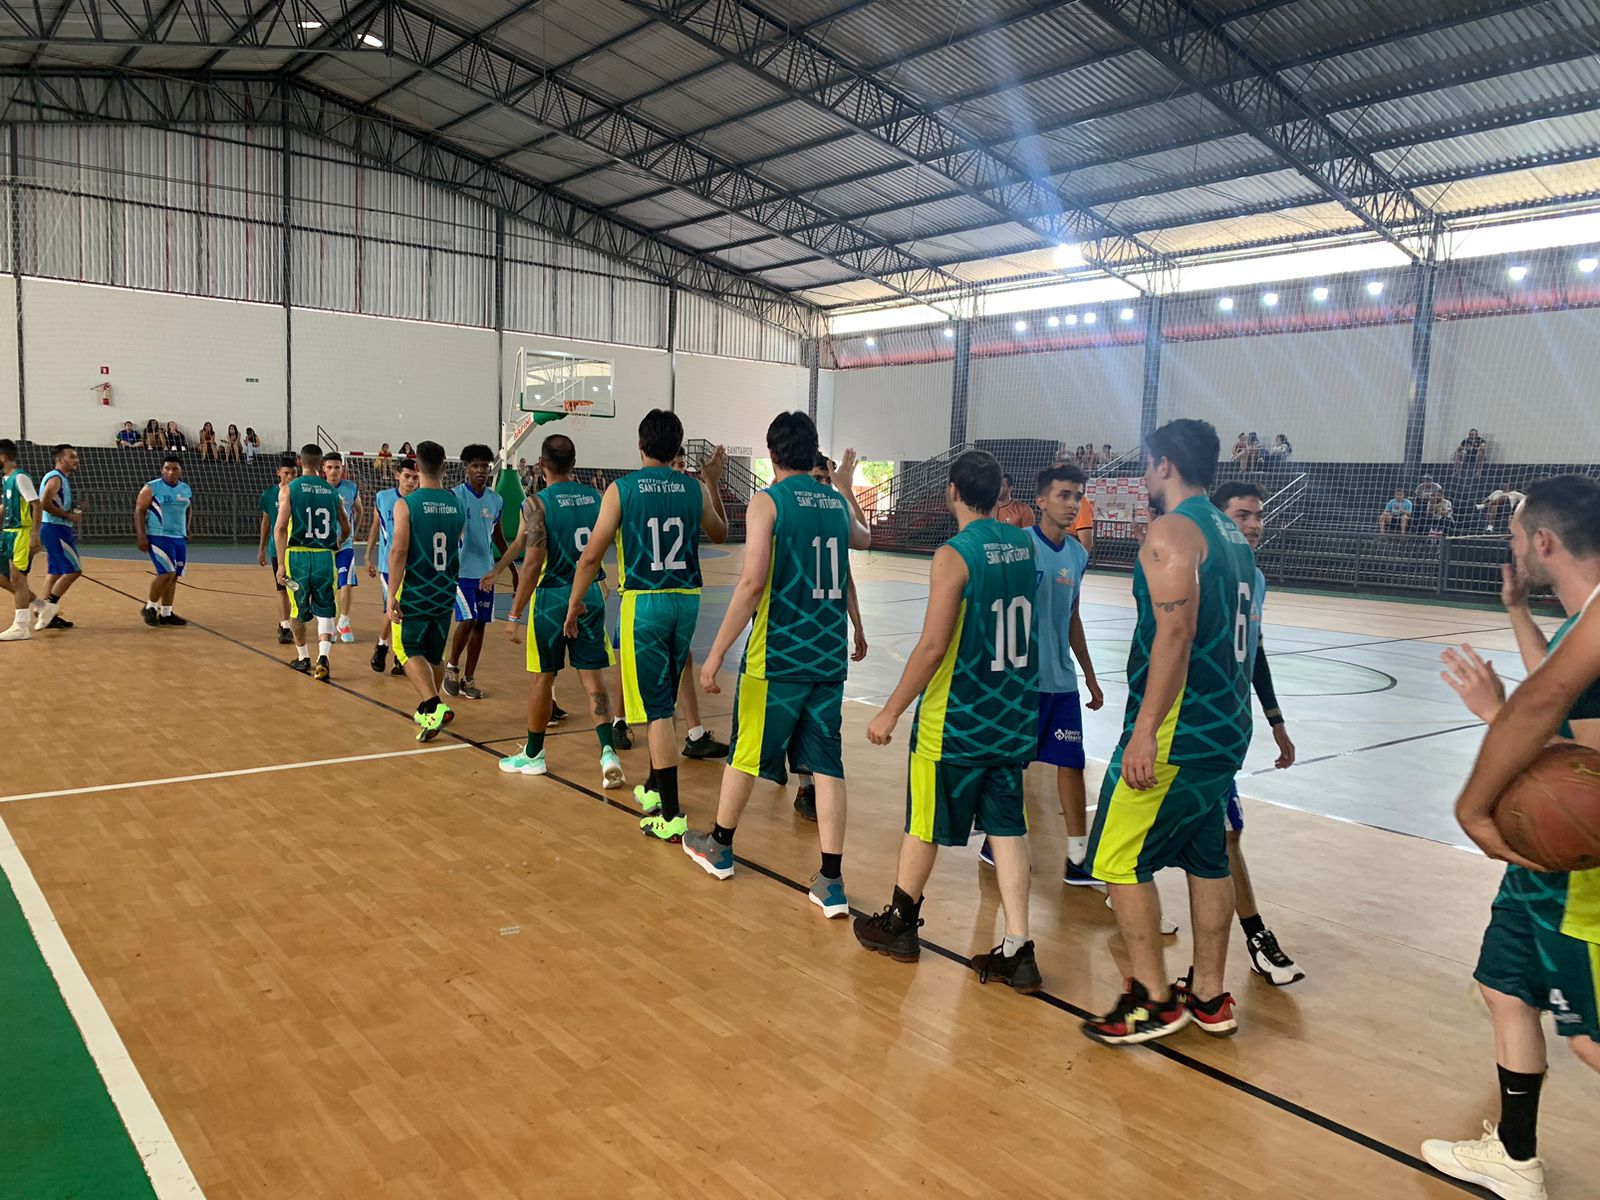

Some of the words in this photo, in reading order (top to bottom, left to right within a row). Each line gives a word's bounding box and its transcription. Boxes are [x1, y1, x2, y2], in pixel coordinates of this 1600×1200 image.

[305, 506, 331, 540] 13
[433, 532, 447, 571] 8
[647, 517, 687, 571] 12
[812, 536, 842, 599] 11
[991, 596, 1032, 671] 10
[1234, 582, 1250, 662] 6
